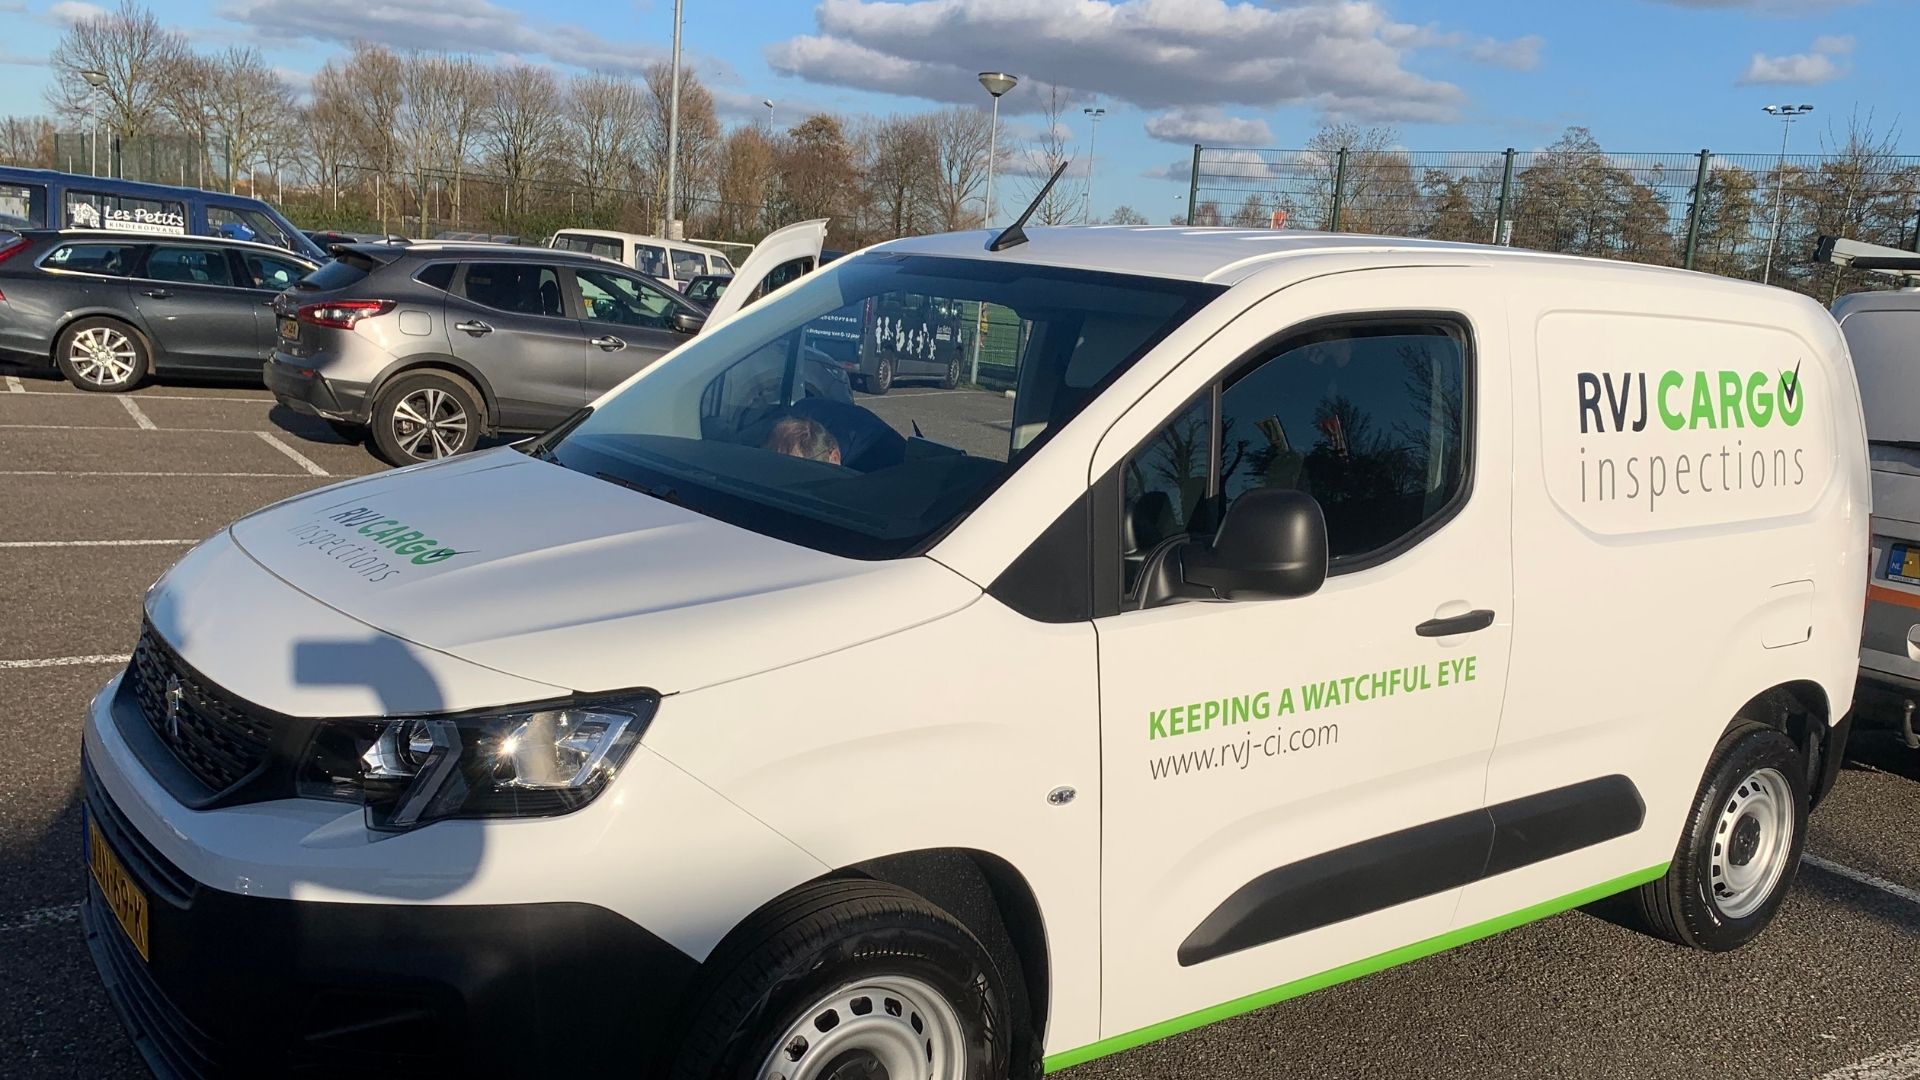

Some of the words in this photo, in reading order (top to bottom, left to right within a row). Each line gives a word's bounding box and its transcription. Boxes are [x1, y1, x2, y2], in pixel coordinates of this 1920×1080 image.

[105, 205, 131, 220] Les
[135, 208, 185, 227] Petits
[109, 220, 181, 235] KINDEROPVANG
[1578, 372, 1648, 433] RVJ
[1657, 370, 1804, 431] CARGO
[1581, 440, 1804, 512] inspections
[287, 520, 400, 582] inspections
[329, 507, 385, 527] RVJ
[357, 520, 457, 565] CARGO
[1149, 691, 1270, 740] KEEPING
[1277, 688, 1295, 716] A
[1301, 664, 1431, 711] WATCHFUL
[1437, 656, 1477, 687] EYE
[1150, 723, 1338, 780] www.rvj-ci.com
